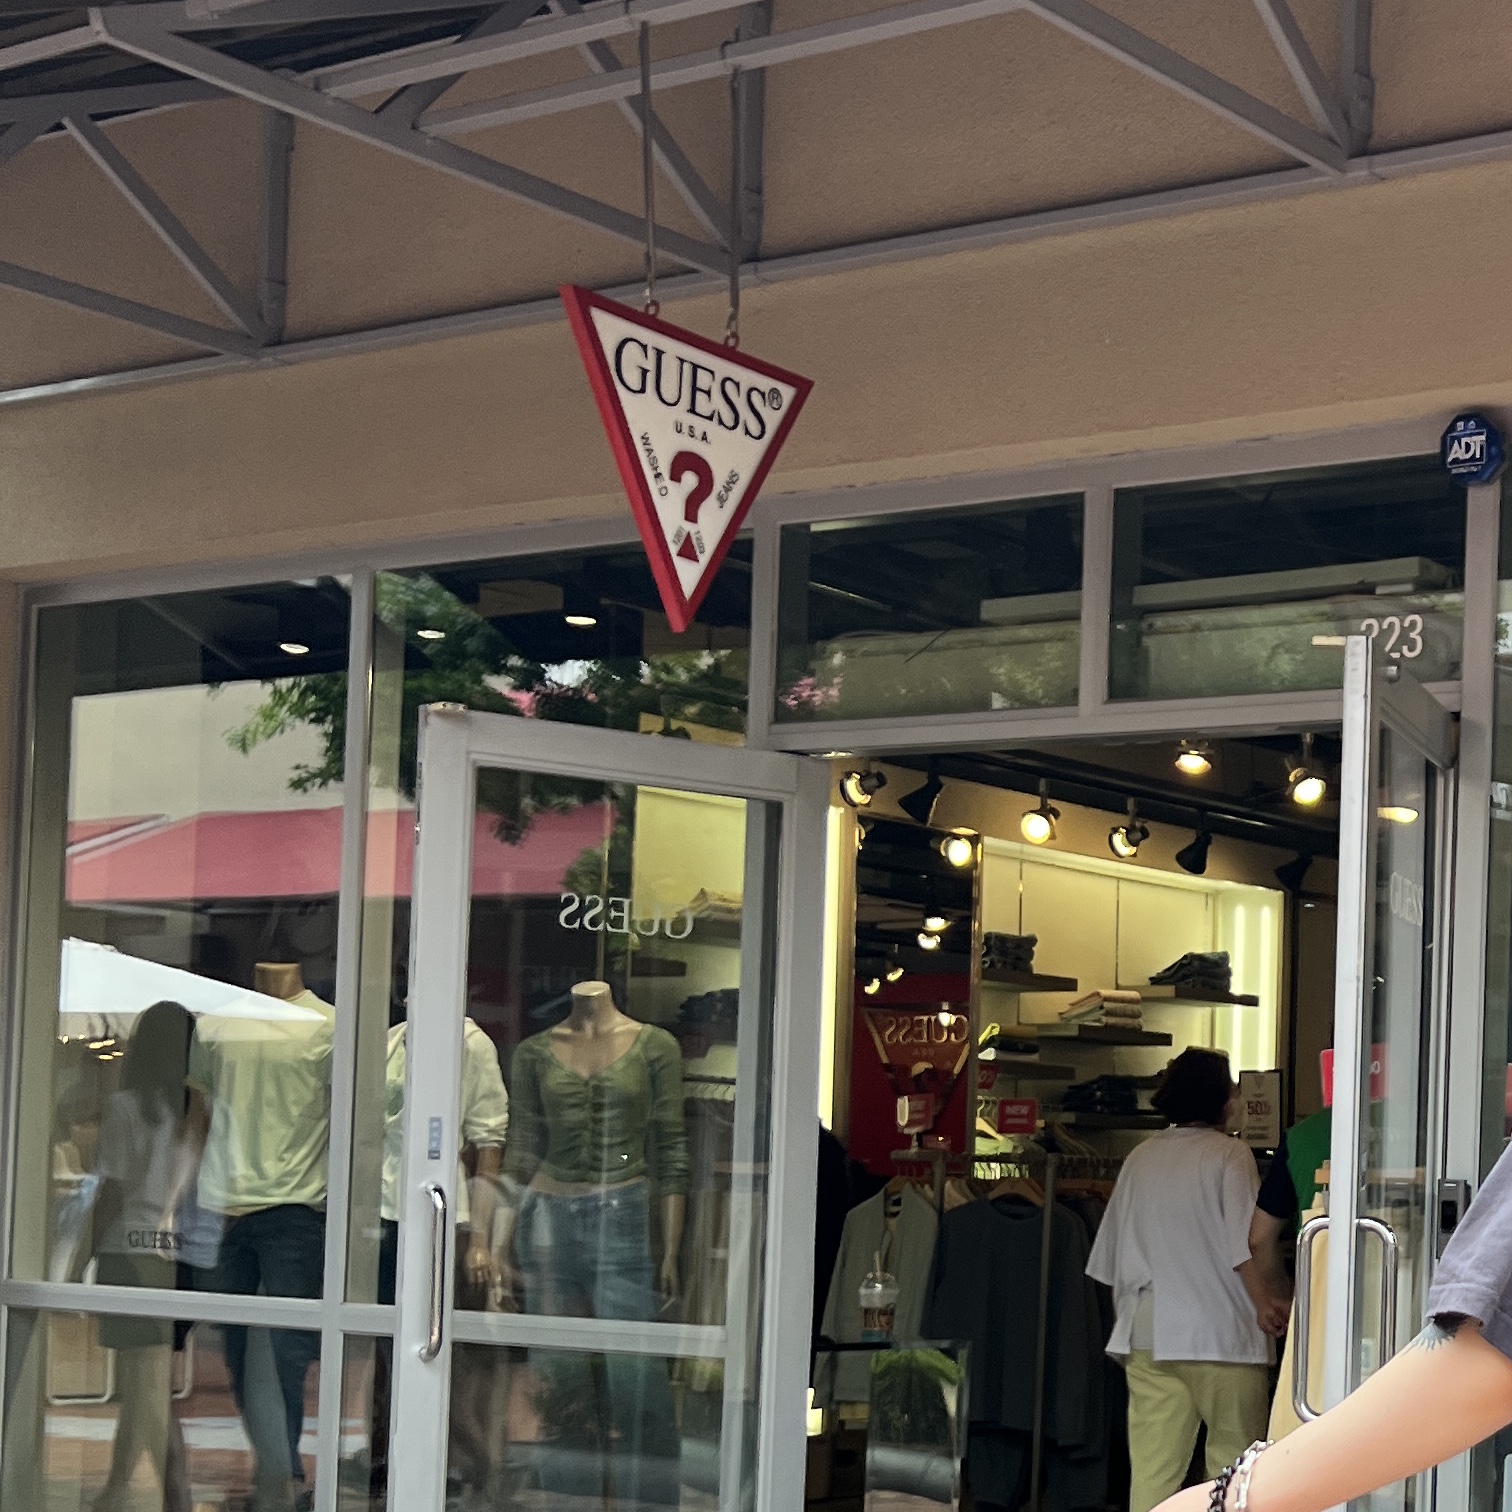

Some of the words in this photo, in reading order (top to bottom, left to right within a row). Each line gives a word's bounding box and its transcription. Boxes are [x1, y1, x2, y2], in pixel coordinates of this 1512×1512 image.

[640, 431, 669, 498] WASHED
[1447, 435, 1486, 462] ADT
[715, 469, 740, 509] JEANS
